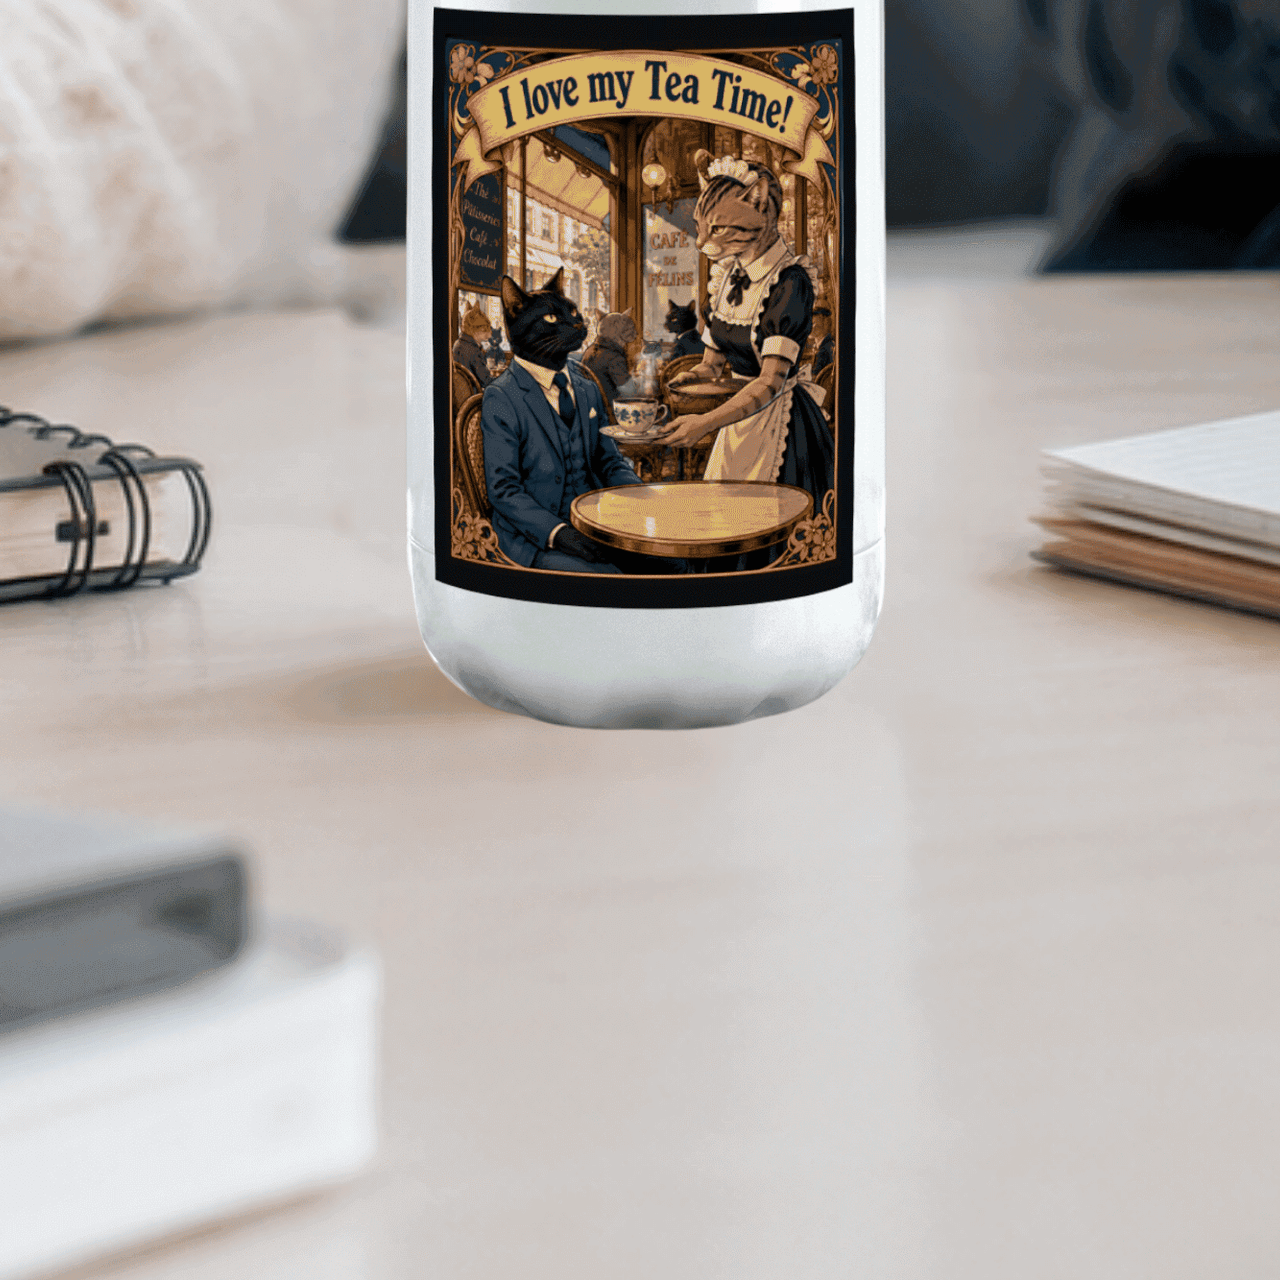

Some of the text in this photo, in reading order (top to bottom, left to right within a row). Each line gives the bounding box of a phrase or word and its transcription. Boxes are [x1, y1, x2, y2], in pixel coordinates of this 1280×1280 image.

[499, 59, 794, 134] I love my Tea Time!
[469, 226, 488, 248] Café
[650, 228, 689, 249] CAFÉ
[463, 248, 497, 270] Chocolat
[663, 256, 677, 266] DE
